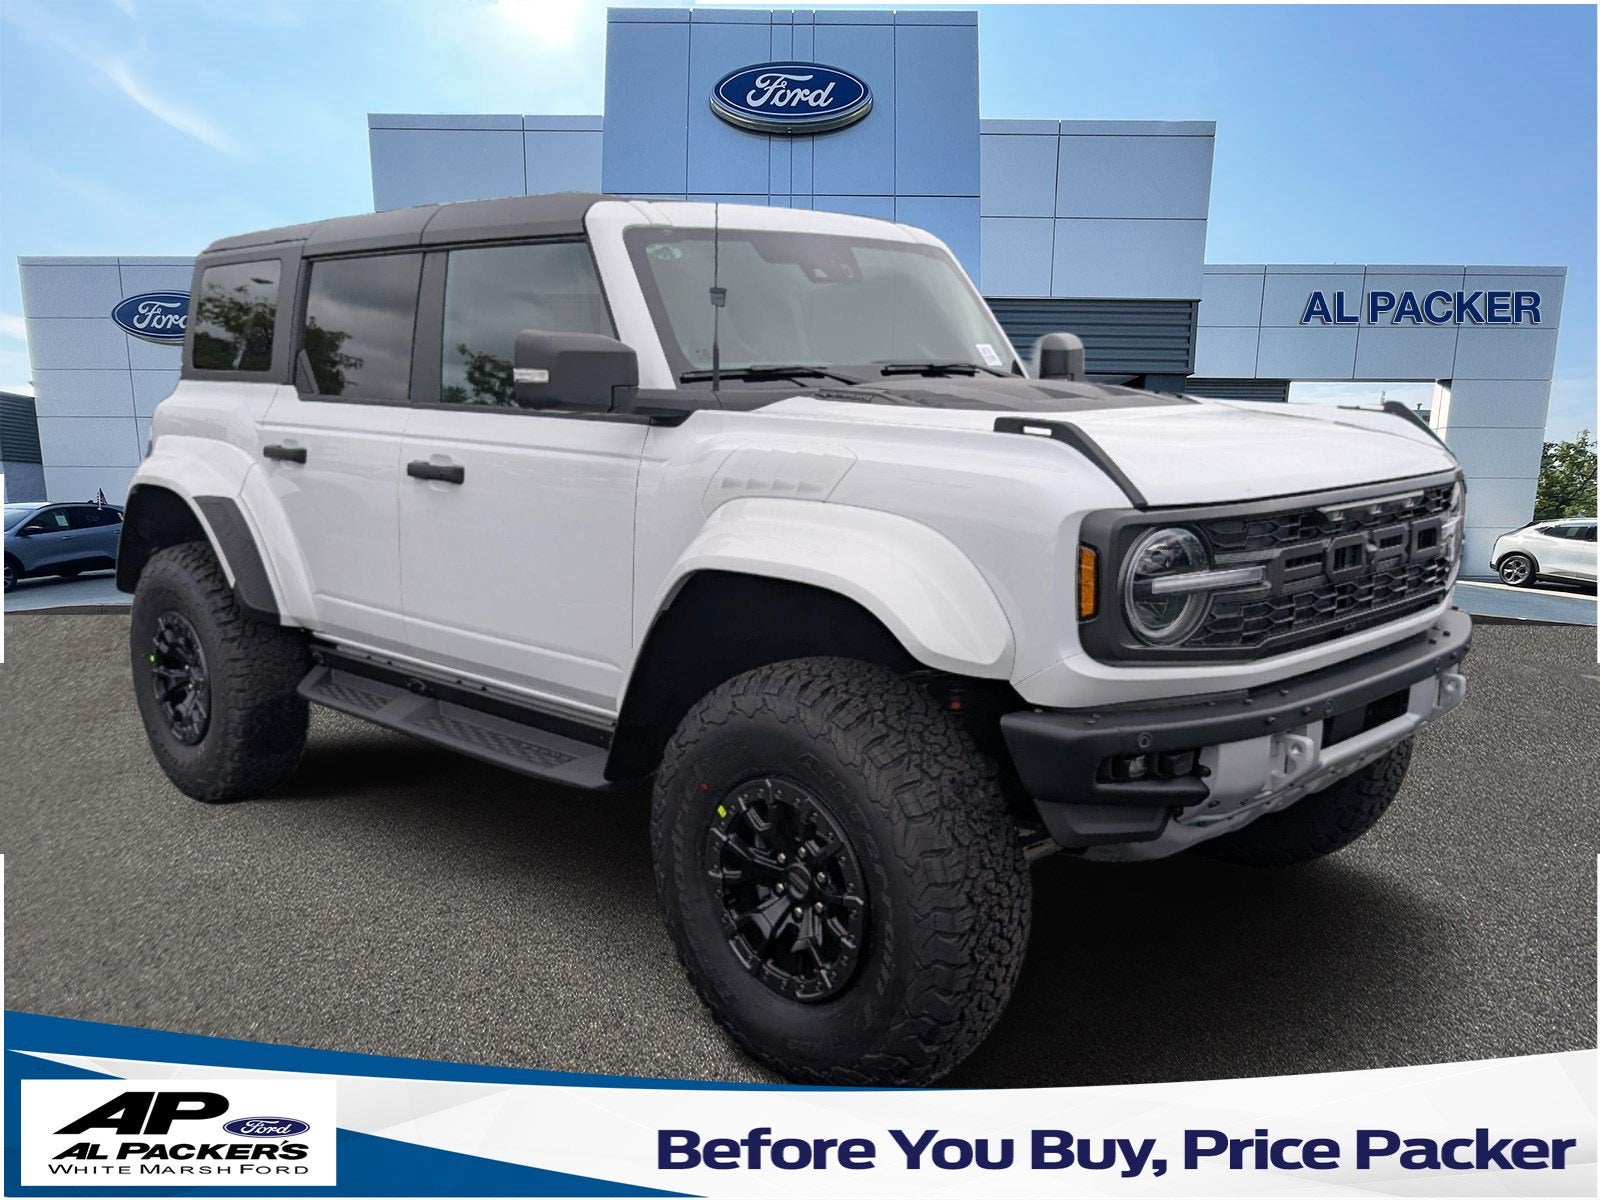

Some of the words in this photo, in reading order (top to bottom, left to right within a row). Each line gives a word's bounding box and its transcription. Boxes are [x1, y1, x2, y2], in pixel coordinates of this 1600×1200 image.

[746, 73, 836, 107] Ford
[1301, 291, 1359, 324] AL
[1369, 290, 1542, 324] PACKER
[1273, 515, 1444, 598] FORD
